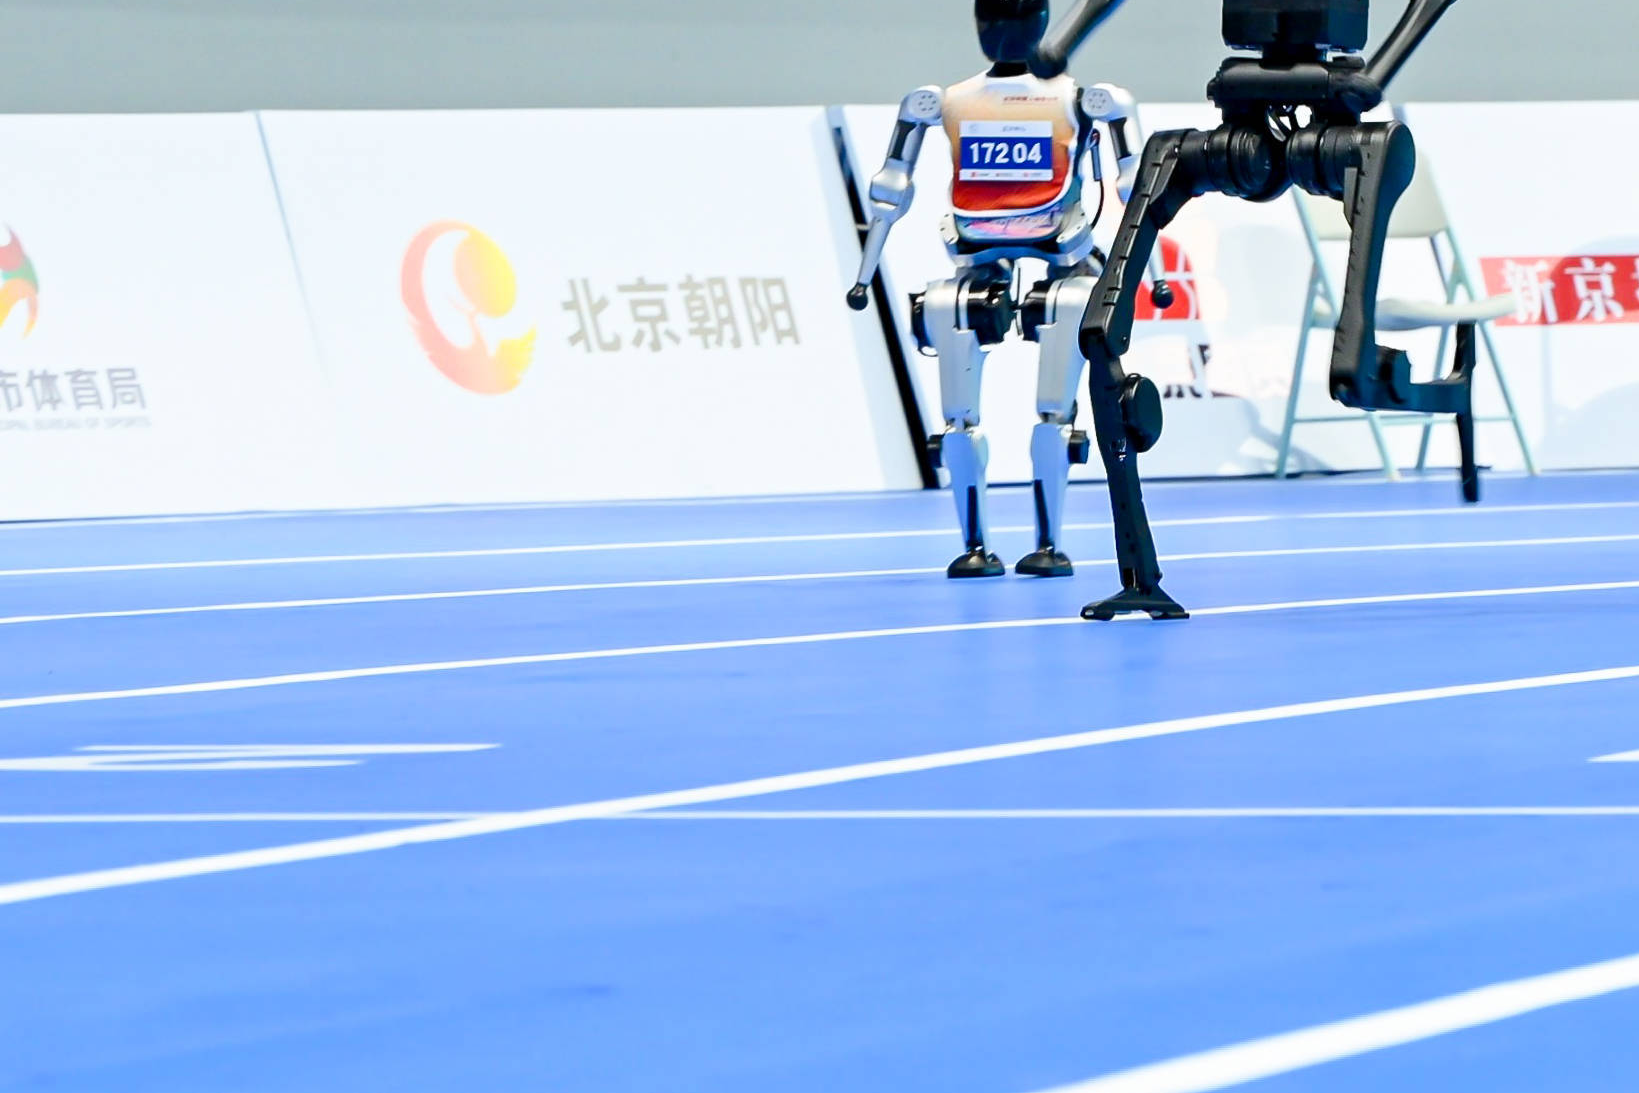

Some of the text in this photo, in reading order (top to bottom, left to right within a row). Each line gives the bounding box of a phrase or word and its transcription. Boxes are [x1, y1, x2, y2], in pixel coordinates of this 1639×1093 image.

[969, 142, 1043, 164] 17204
[561, 274, 802, 353] 北京朝阳
